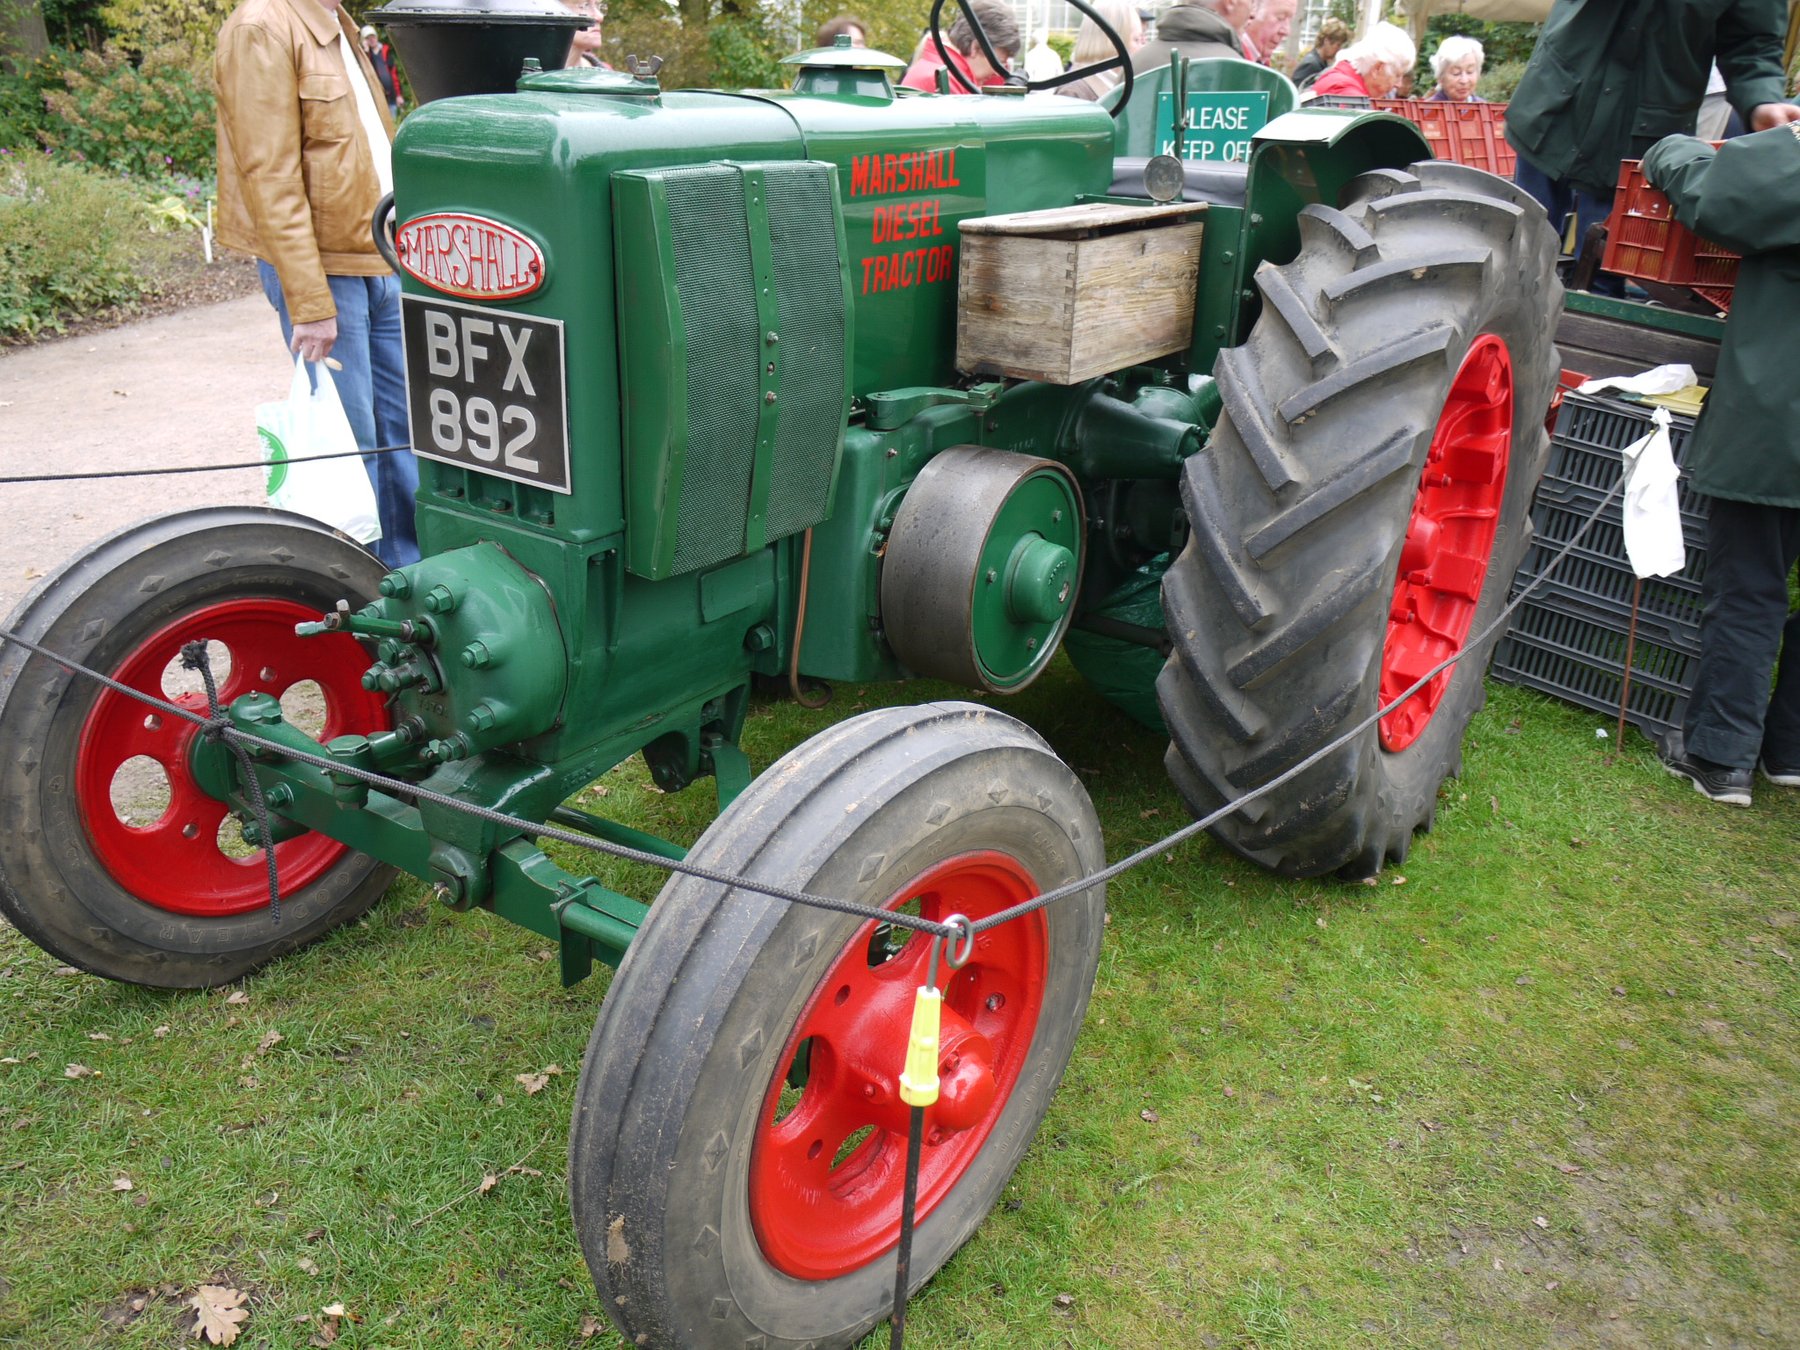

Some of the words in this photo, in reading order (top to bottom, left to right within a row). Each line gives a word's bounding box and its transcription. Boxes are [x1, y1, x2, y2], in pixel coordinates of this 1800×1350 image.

[1186, 107, 1250, 130] LEASE
[850, 149, 960, 197] MARSHALL
[872, 200, 943, 244] DIESEL
[404, 223, 532, 292] MARSHALL
[861, 245, 954, 296] TRACTOR
[424, 310, 537, 396] BFX
[429, 388, 539, 474] 892
